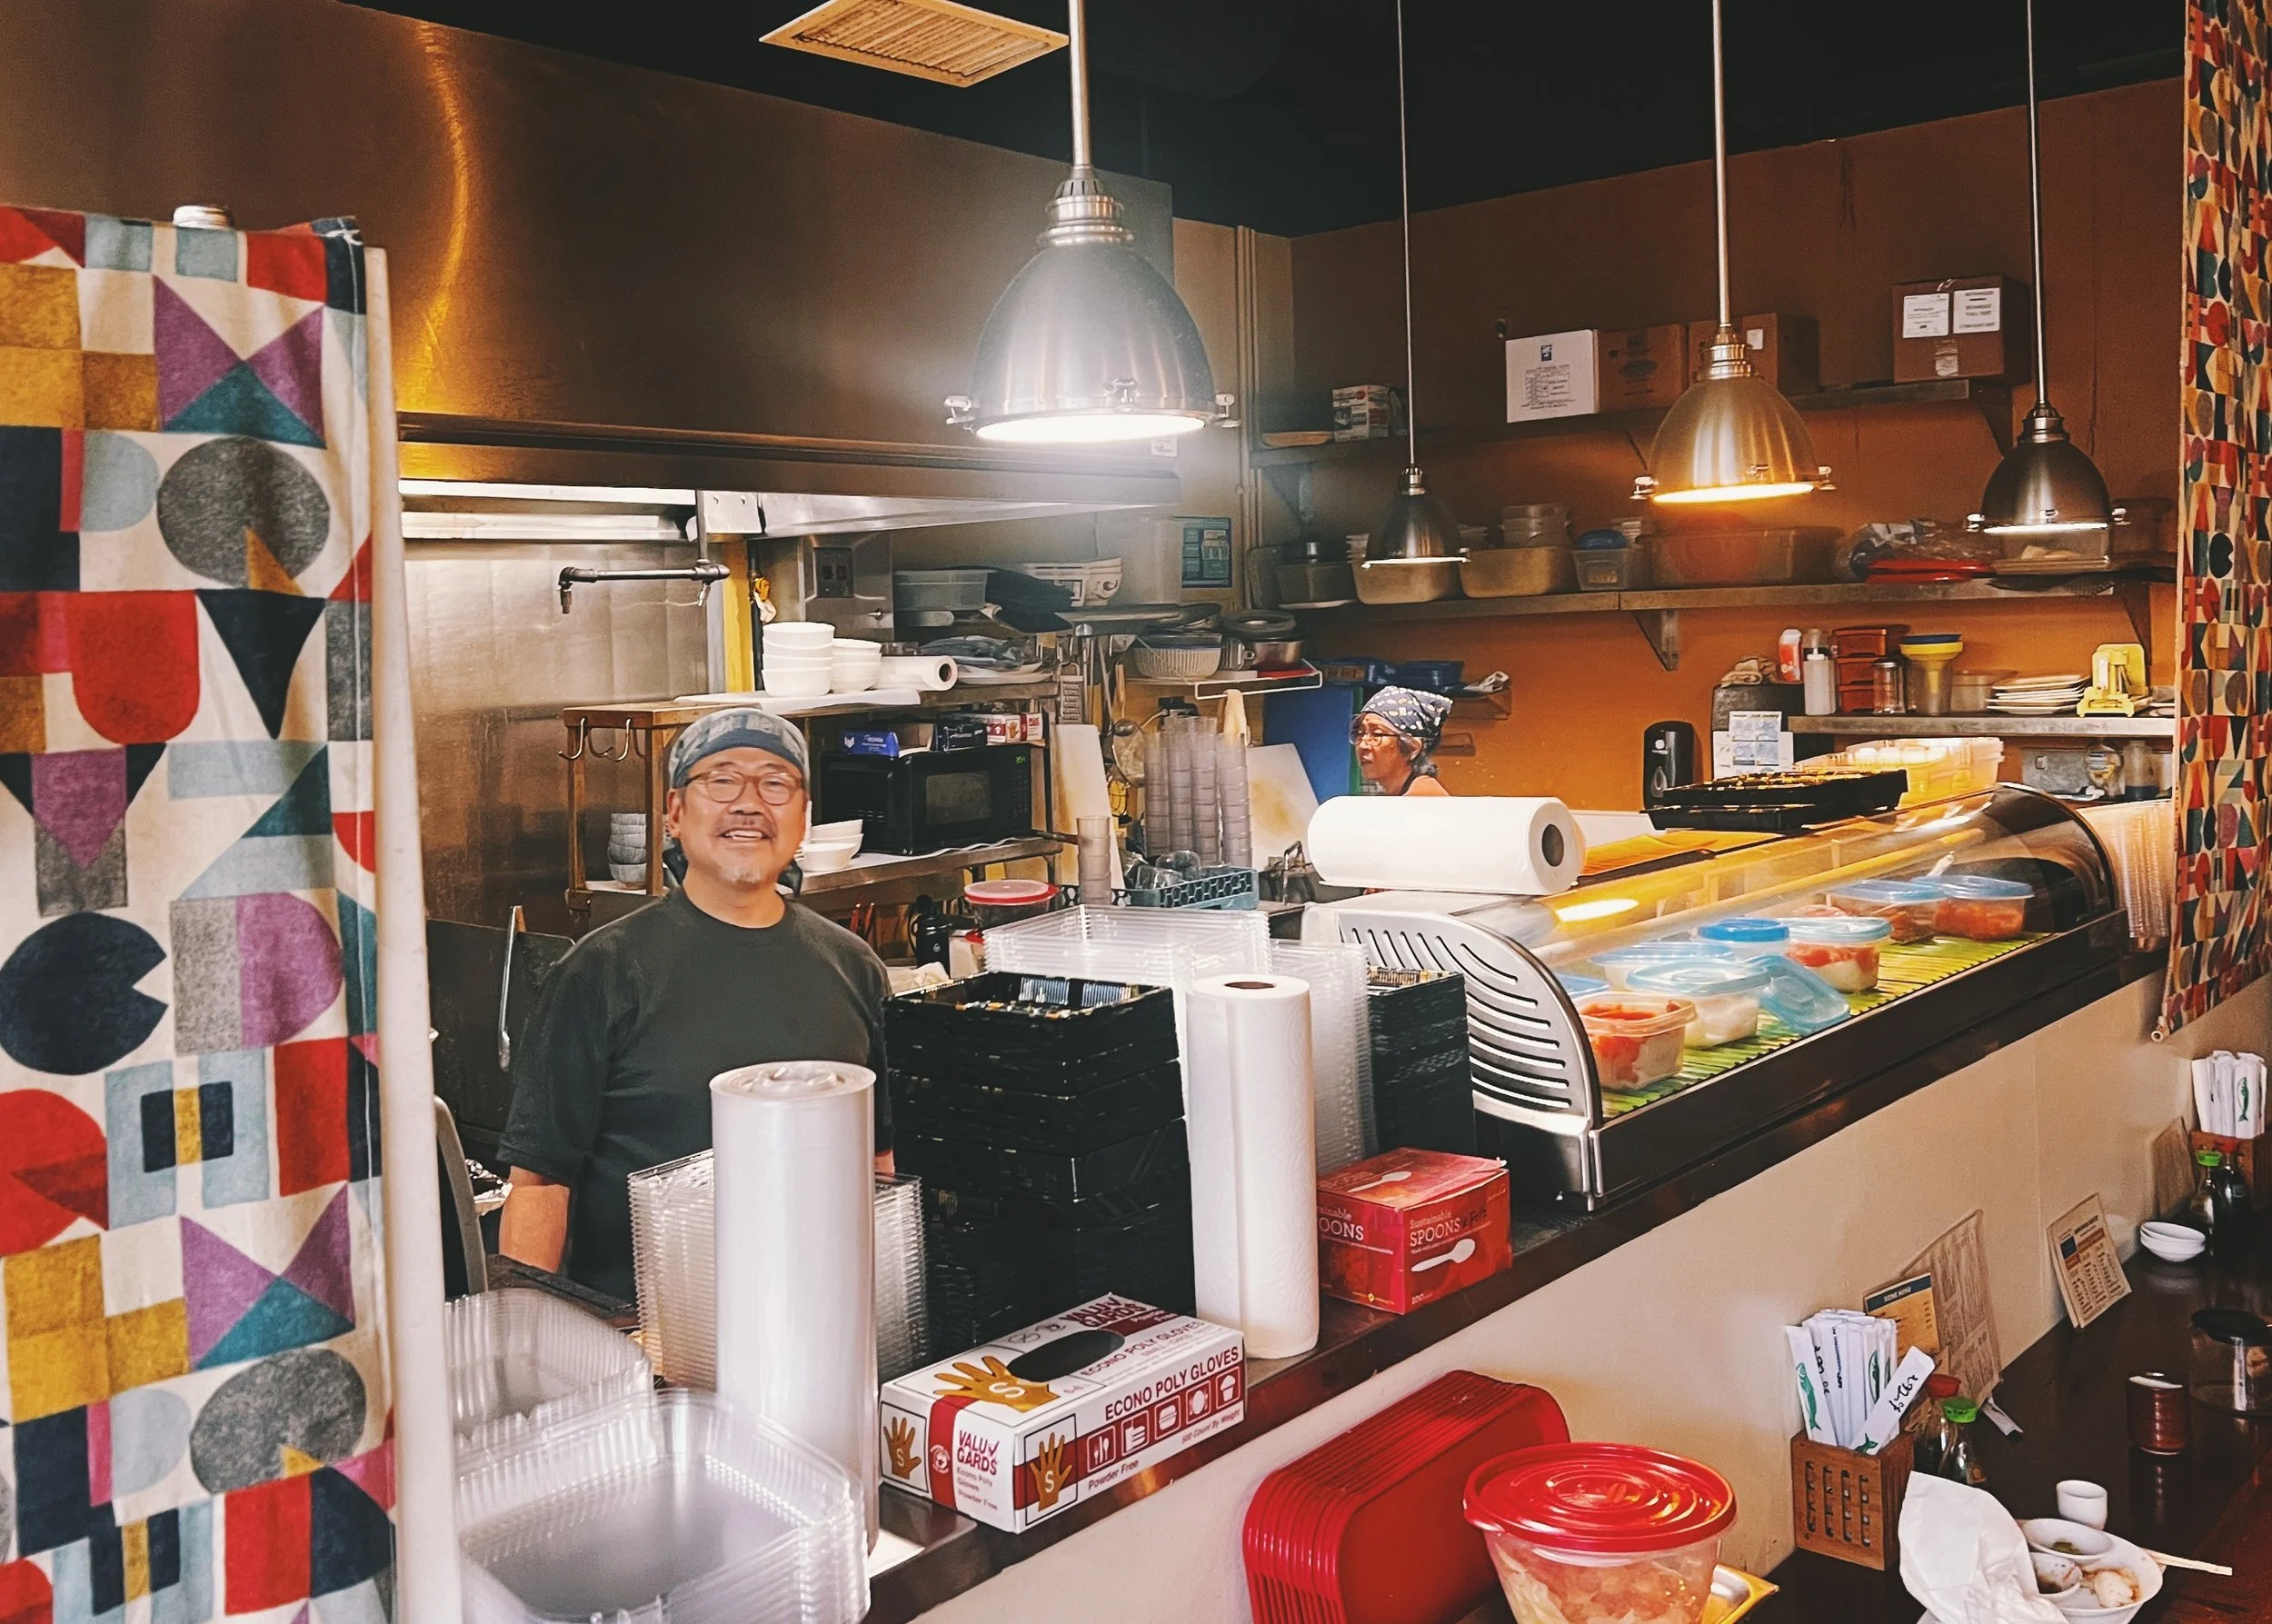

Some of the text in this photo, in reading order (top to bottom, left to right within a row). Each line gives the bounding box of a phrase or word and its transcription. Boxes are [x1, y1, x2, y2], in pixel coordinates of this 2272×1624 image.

[1319, 1217, 1364, 1241] OONS
[1410, 1218, 1460, 1247] SPOONS
[1081, 1352, 1127, 1376] ECONO
[1125, 1338, 1158, 1355] POLY
[1156, 1320, 1206, 1341] GLOVES
[989, 1382, 1025, 1398] S
[1105, 1387, 1152, 1421] ECONO
[1156, 1369, 1187, 1398] POLY
[1190, 1346, 1239, 1380] GLOVES
[959, 1430, 988, 1454] VALU
[896, 1448, 905, 1467] S
[957, 1447, 997, 1476] GARDS
[1044, 1470, 1055, 1492] S
[1088, 1460, 1139, 1491] Powder Free
